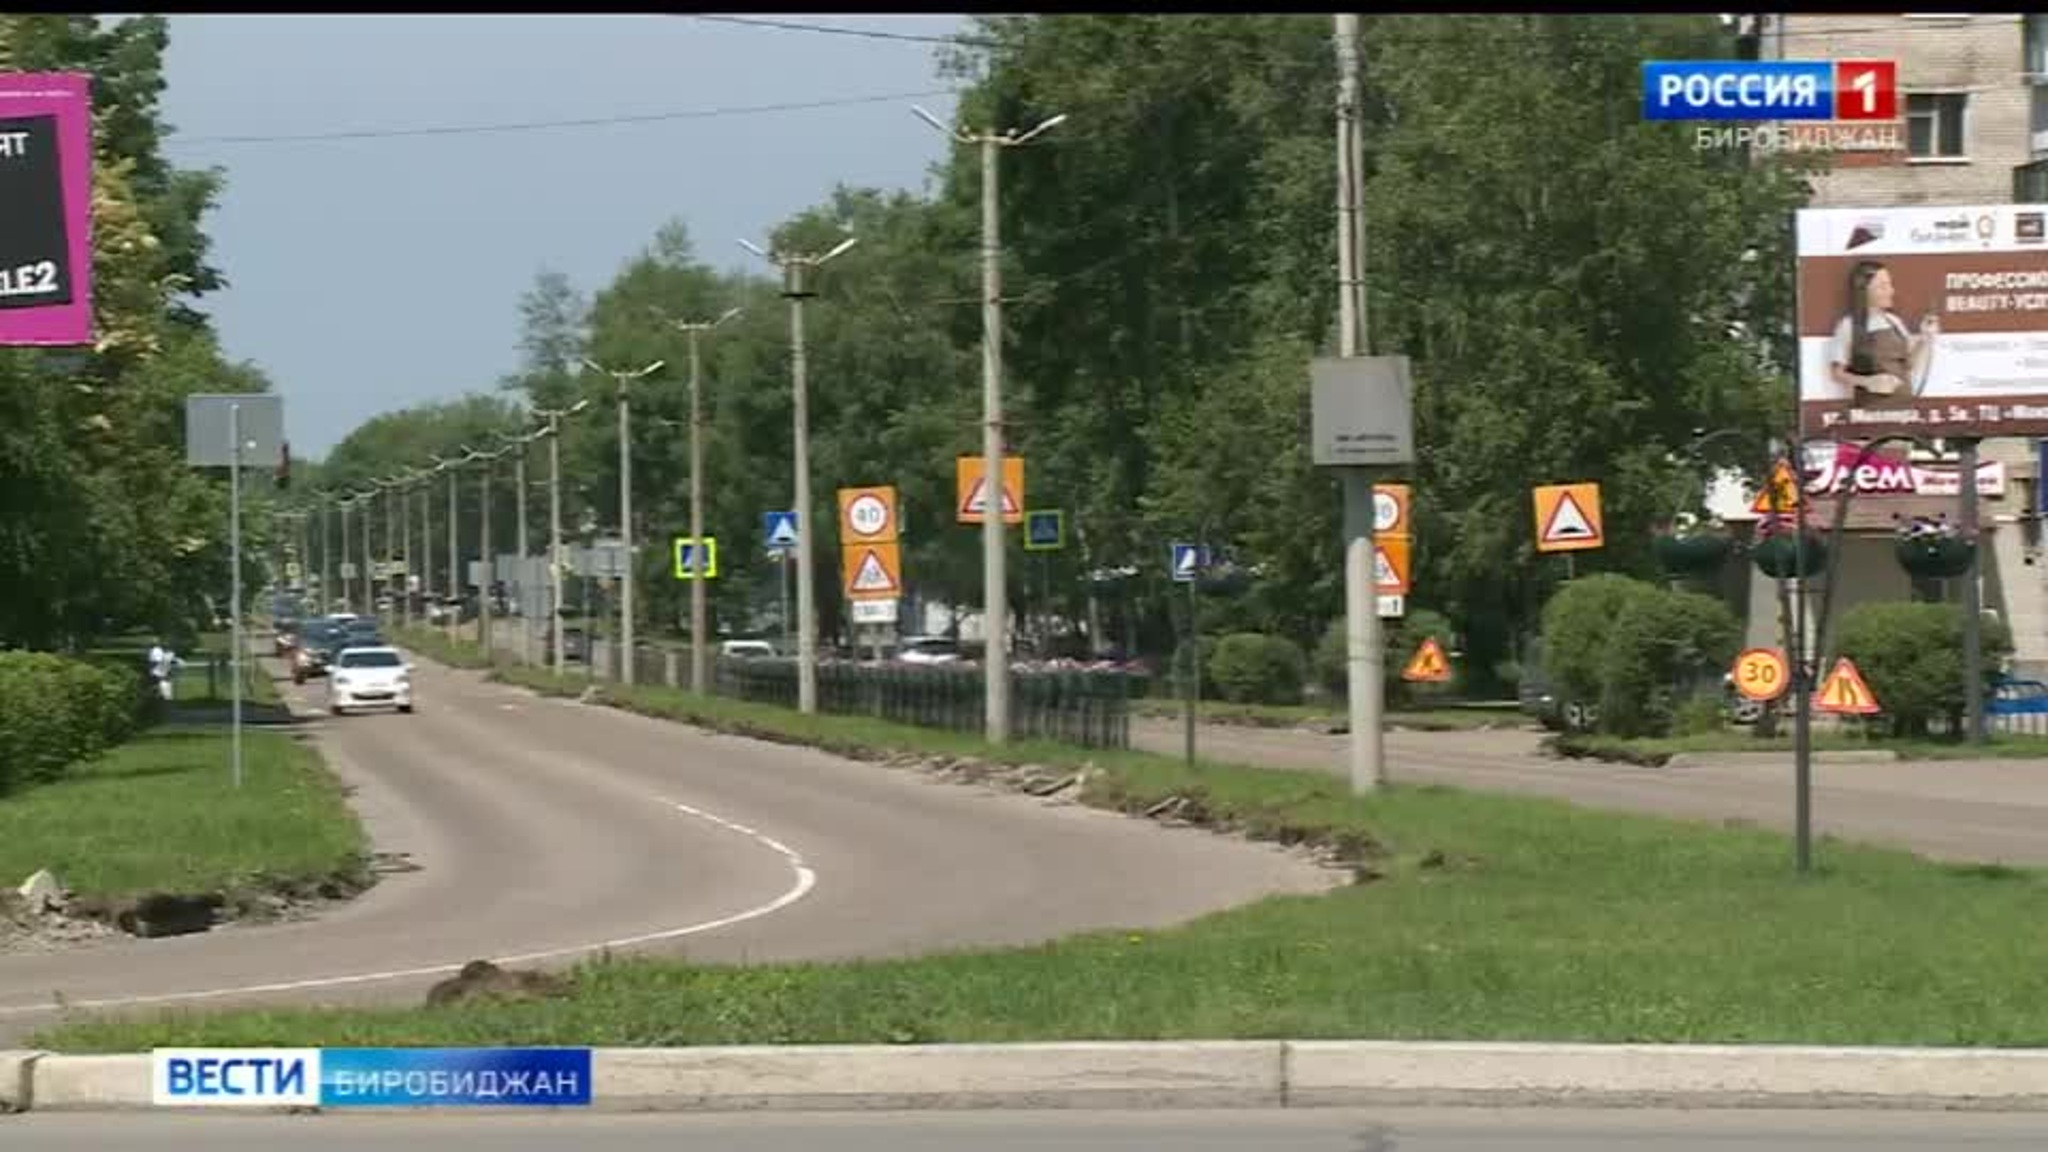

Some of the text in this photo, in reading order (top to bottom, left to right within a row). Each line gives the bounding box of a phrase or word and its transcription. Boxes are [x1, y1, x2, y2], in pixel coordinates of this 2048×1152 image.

[0, 261, 58, 295] LE2
[856, 507, 880, 522] 40
[1745, 662, 1777, 684] 30
